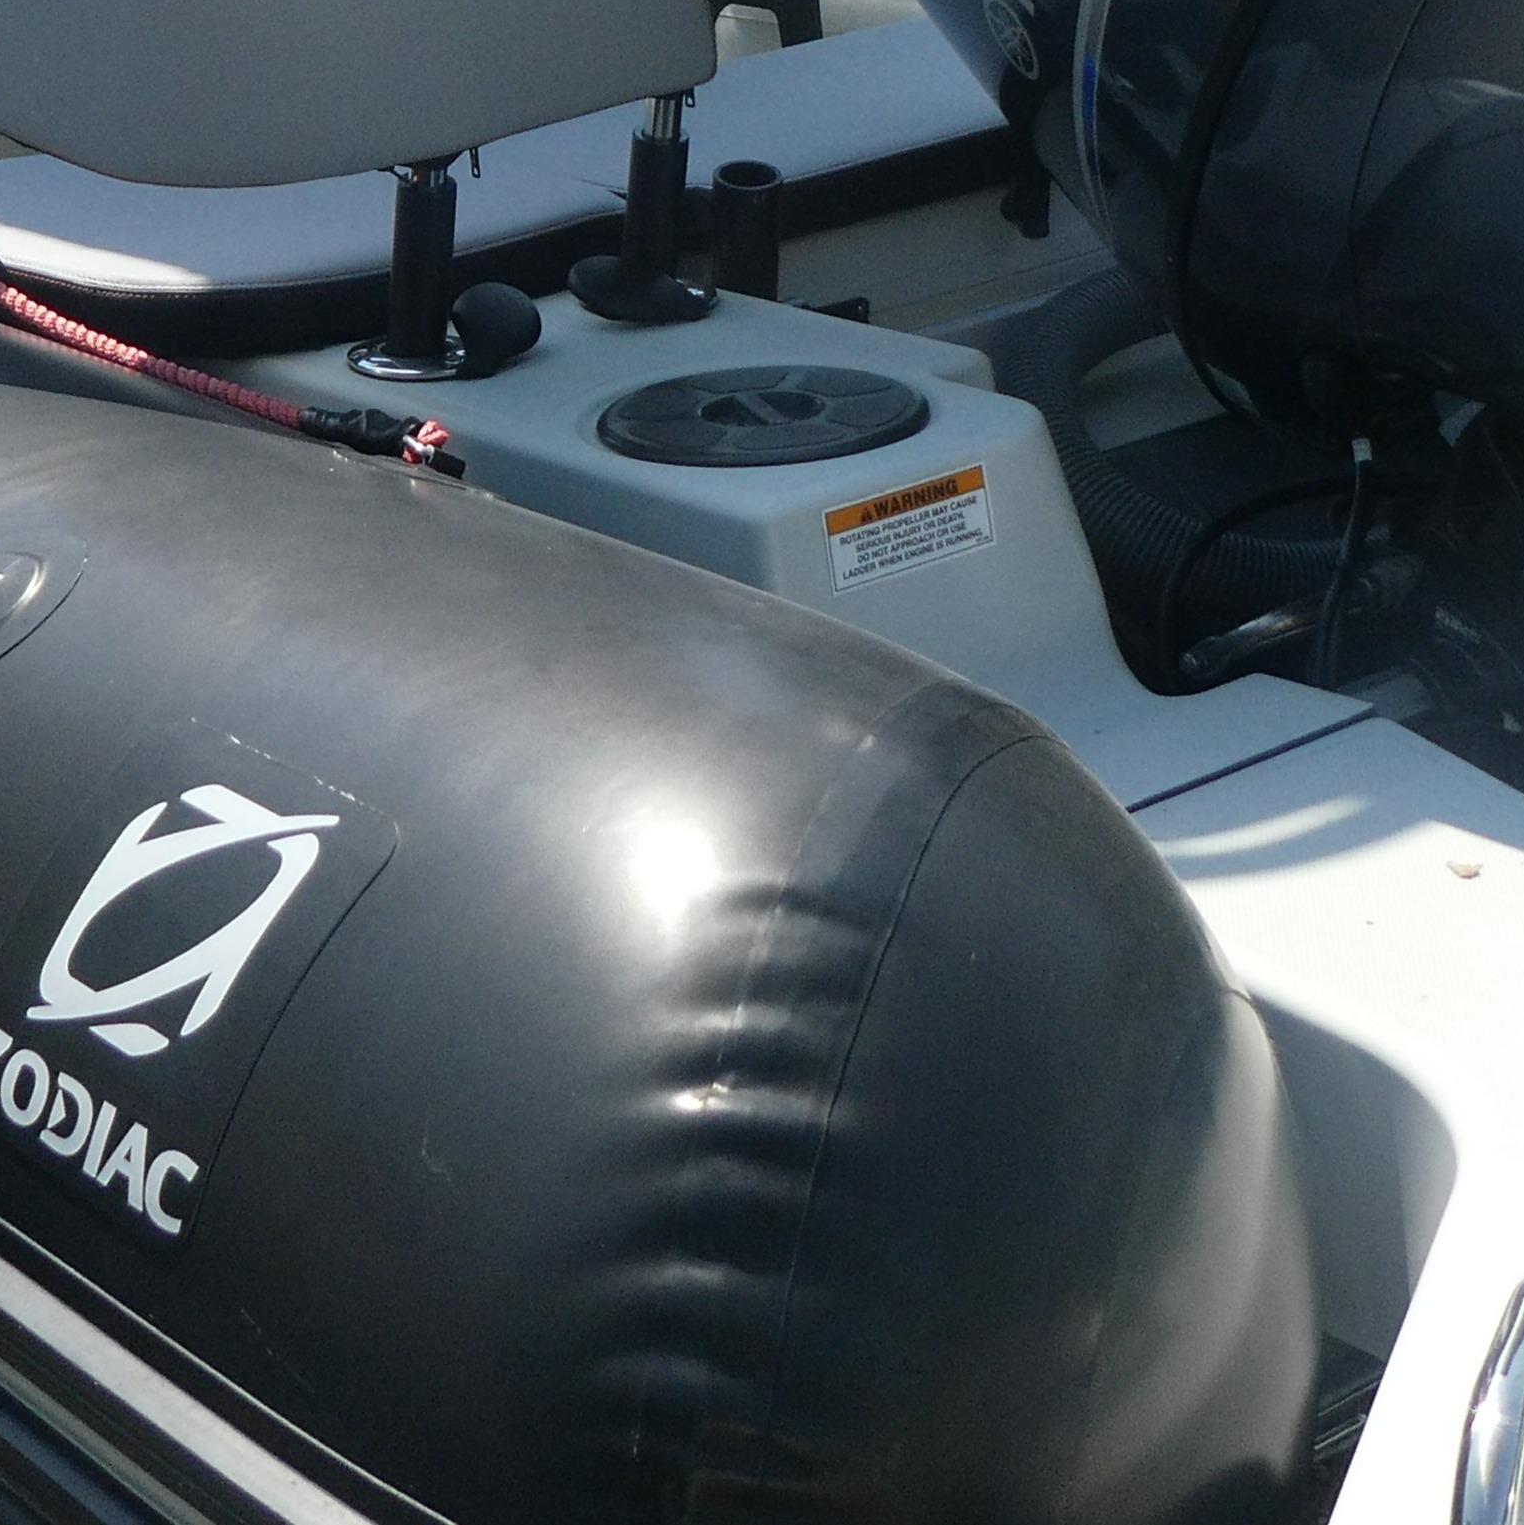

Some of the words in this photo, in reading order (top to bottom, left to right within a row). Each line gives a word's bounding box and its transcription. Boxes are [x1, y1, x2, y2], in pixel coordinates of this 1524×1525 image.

[873, 478, 959, 517] WARNING
[840, 526, 880, 546] ROTATING
[882, 509, 931, 532] PROPELLER
[932, 505, 948, 519] MAY
[950, 496, 977, 512] CAUSE
[855, 535, 891, 552] SERIOUS
[893, 526, 922, 541] INJURY
[924, 521, 936, 532] OR
[843, 563, 877, 580] LADDER
[878, 554, 903, 569] WHEN
[905, 544, 935, 561] ENGINE
[857, 552, 869, 564] DO
[871, 546, 889, 559] NOT
[891, 532, 935, 554] APPROACH
[951, 522, 967, 535] USE
